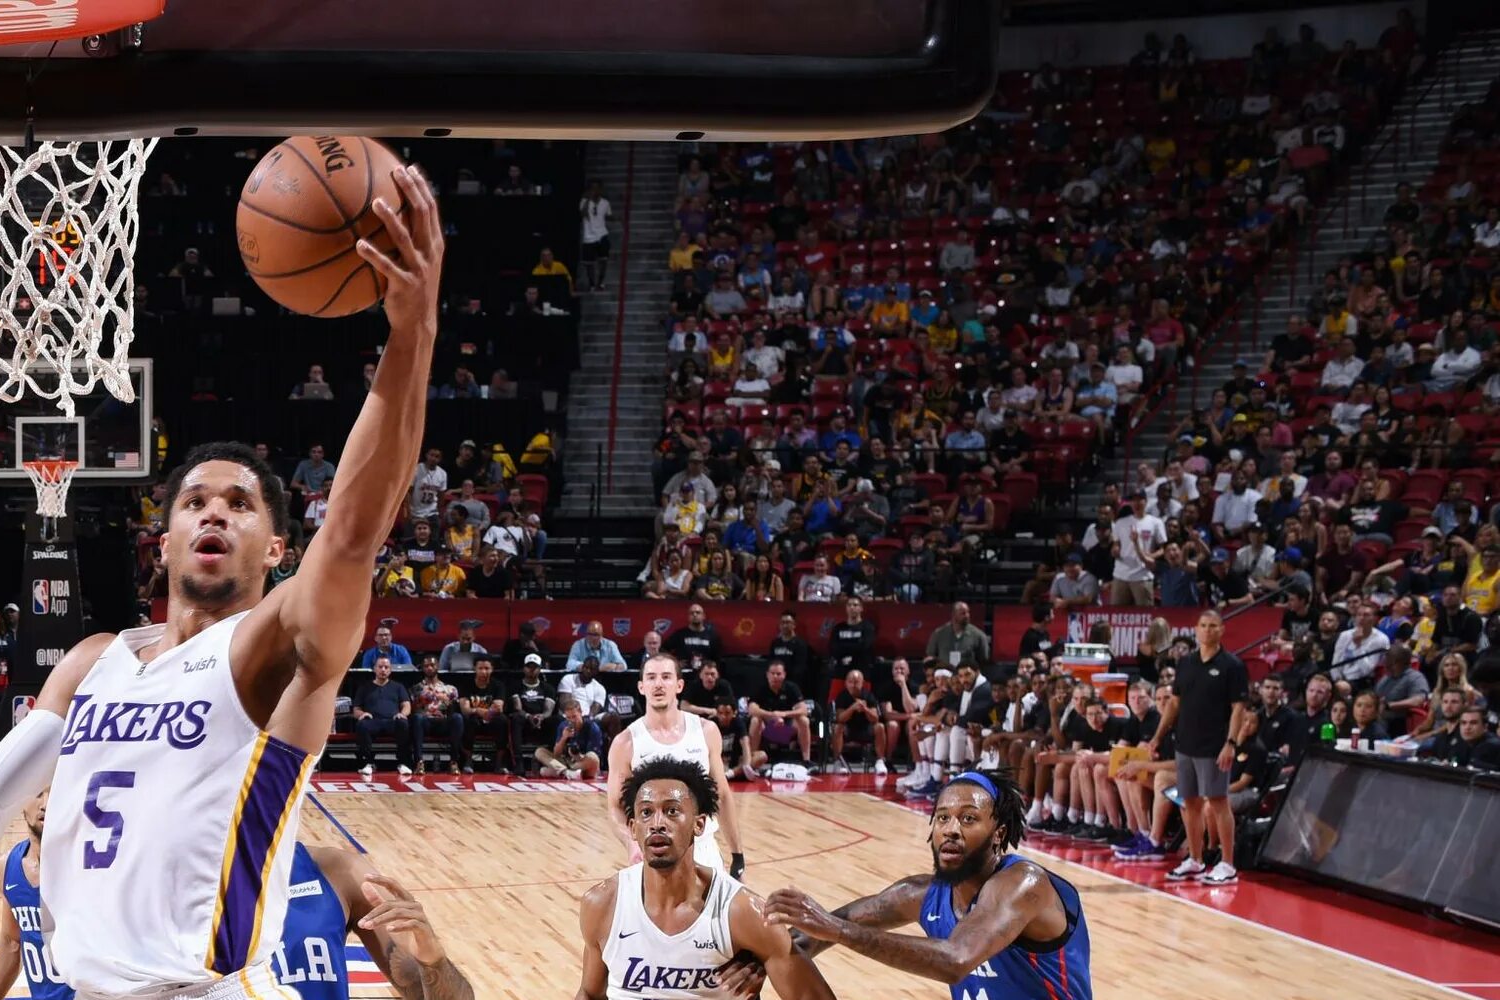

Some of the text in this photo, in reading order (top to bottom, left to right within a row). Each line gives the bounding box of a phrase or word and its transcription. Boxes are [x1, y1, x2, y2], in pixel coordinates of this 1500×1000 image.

[51, 580, 70, 597] NBA
[51, 597, 68, 616] App
[1088, 613, 1152, 625] MGM RESORTS
[183, 655, 217, 674] wish
[60, 694, 213, 756] LAKERS
[83, 771, 136, 870] 5
